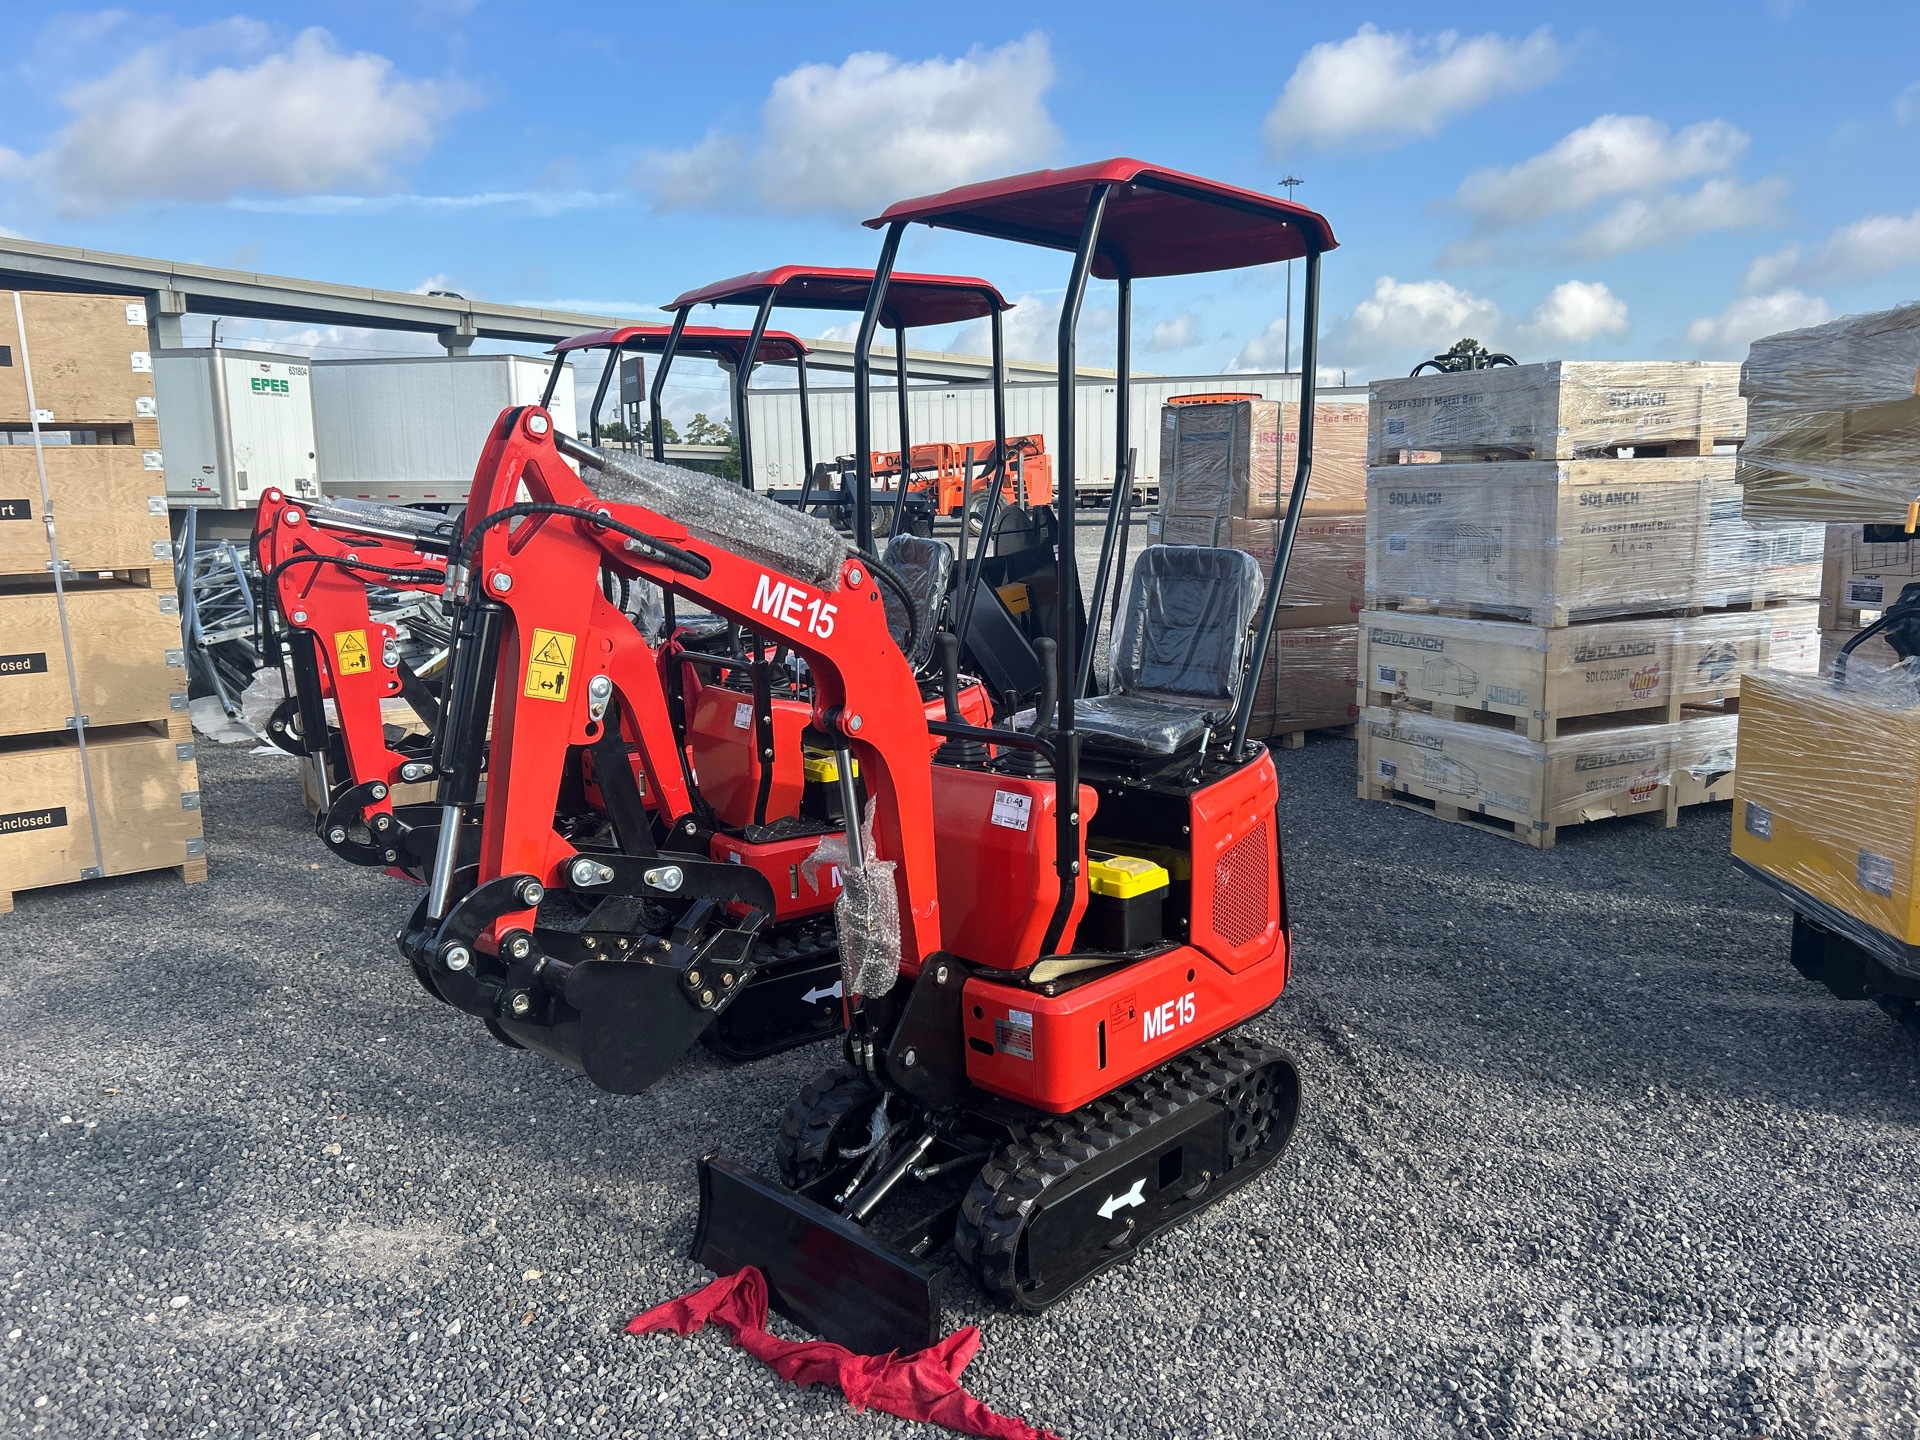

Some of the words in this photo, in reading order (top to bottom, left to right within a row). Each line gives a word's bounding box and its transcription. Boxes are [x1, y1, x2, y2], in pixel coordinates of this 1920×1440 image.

[288, 365, 308, 376] 631804
[251, 377, 290, 393] EPES
[1434, 395, 1460, 407] Metal
[1, 504, 15, 516] rt
[1350, 525, 1366, 533] Gol
[1630, 521, 1655, 532] Metal
[751, 573, 838, 639] ME15
[1383, 630, 1444, 650] SDLANCH
[1, 658, 31, 671] osed
[1585, 668, 1630, 683] SDLC2030FT
[1634, 673, 1655, 690] HOT
[1633, 690, 1651, 700] SALE
[1381, 725, 1444, 750] SDLANCH
[1143, 992, 1196, 1042] ME15
